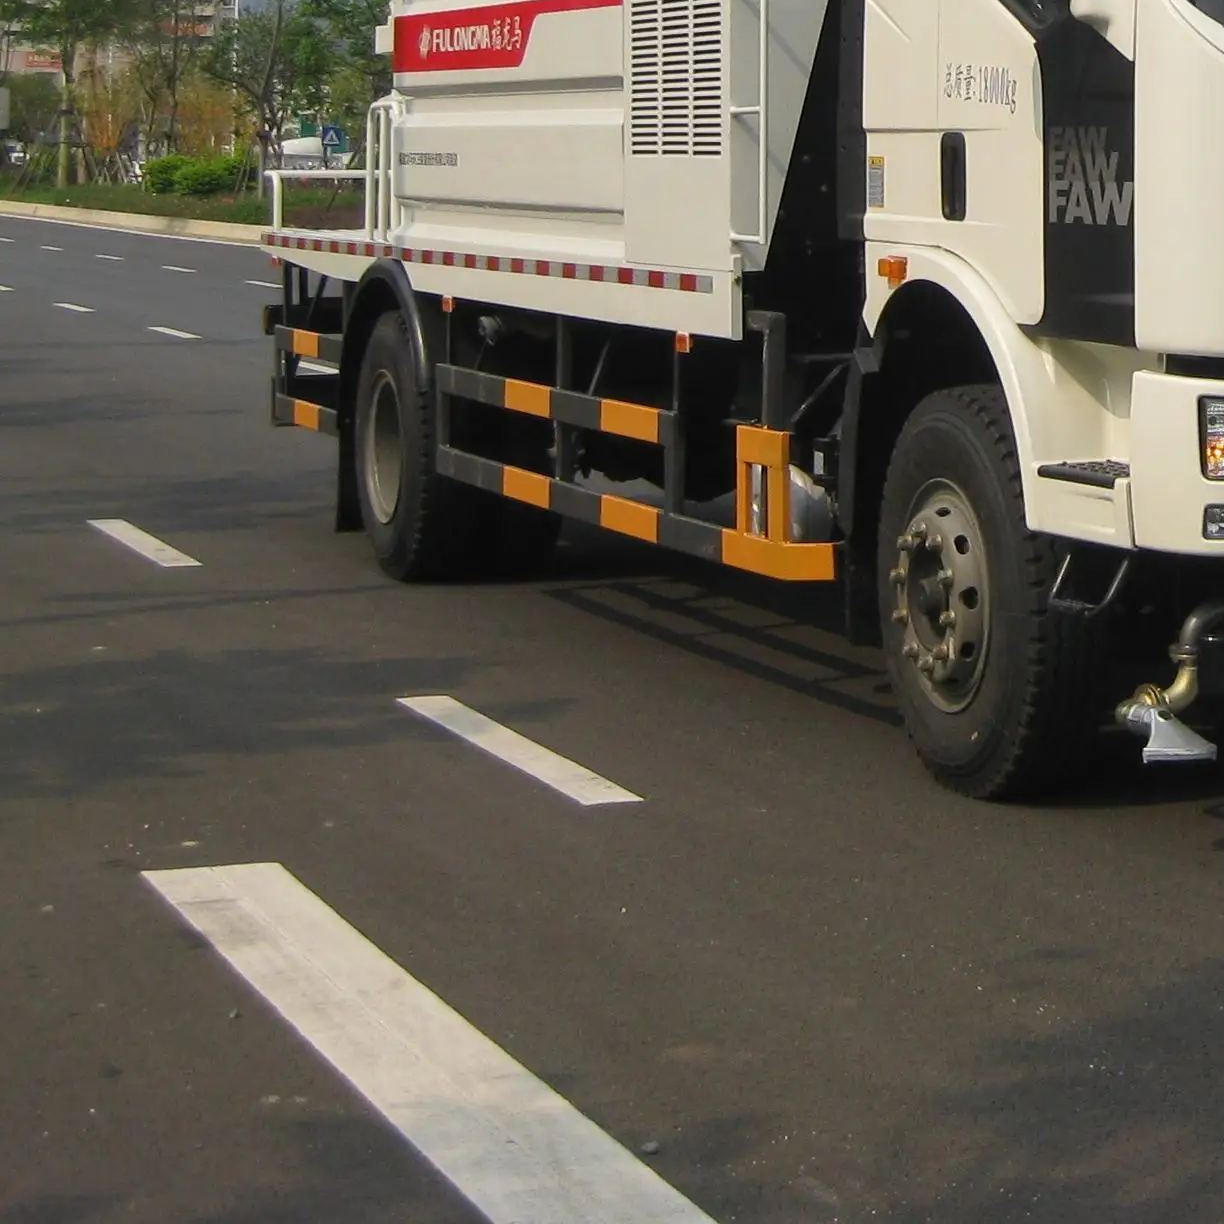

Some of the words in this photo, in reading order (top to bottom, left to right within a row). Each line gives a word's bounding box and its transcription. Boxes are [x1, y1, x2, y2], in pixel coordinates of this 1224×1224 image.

[1051, 127, 1107, 153] FAW
[1050, 152, 1119, 181] FAW
[1048, 181, 1135, 226] FAW
